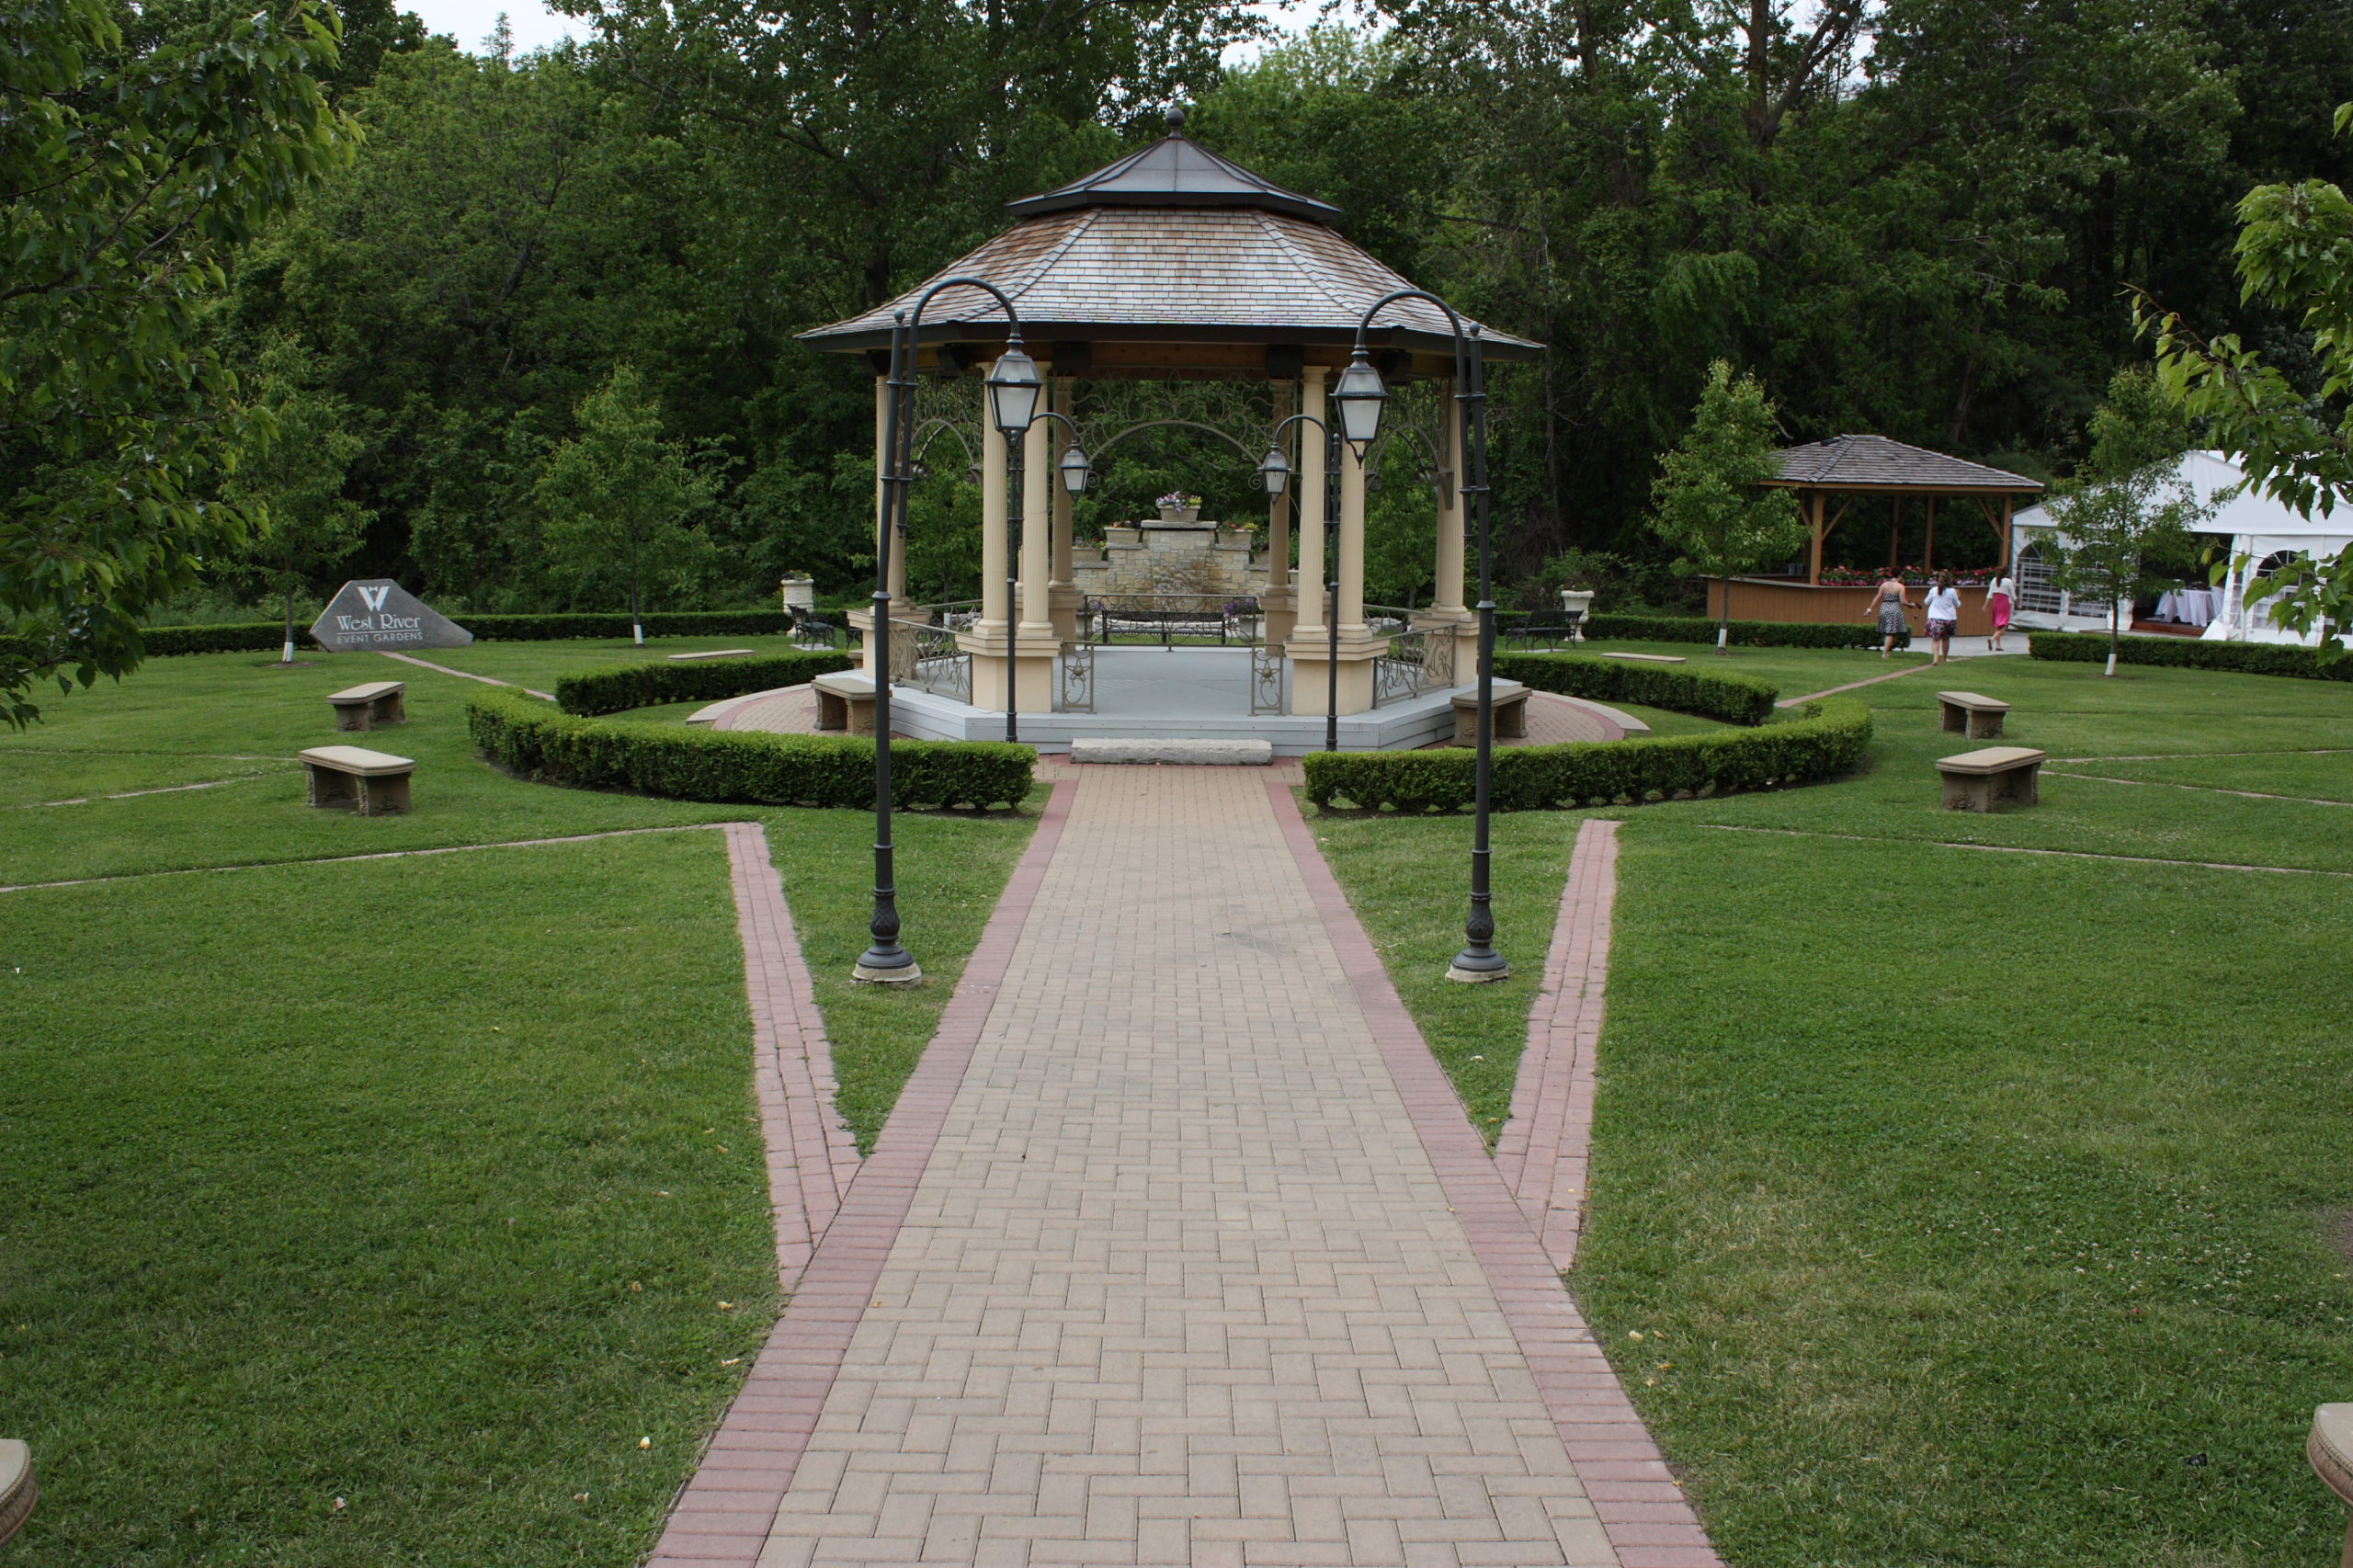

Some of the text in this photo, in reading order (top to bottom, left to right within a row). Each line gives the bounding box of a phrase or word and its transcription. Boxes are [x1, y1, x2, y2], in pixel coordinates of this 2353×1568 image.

[336, 613, 421, 631] West River
[337, 631, 423, 644] EVENT GARDENS
